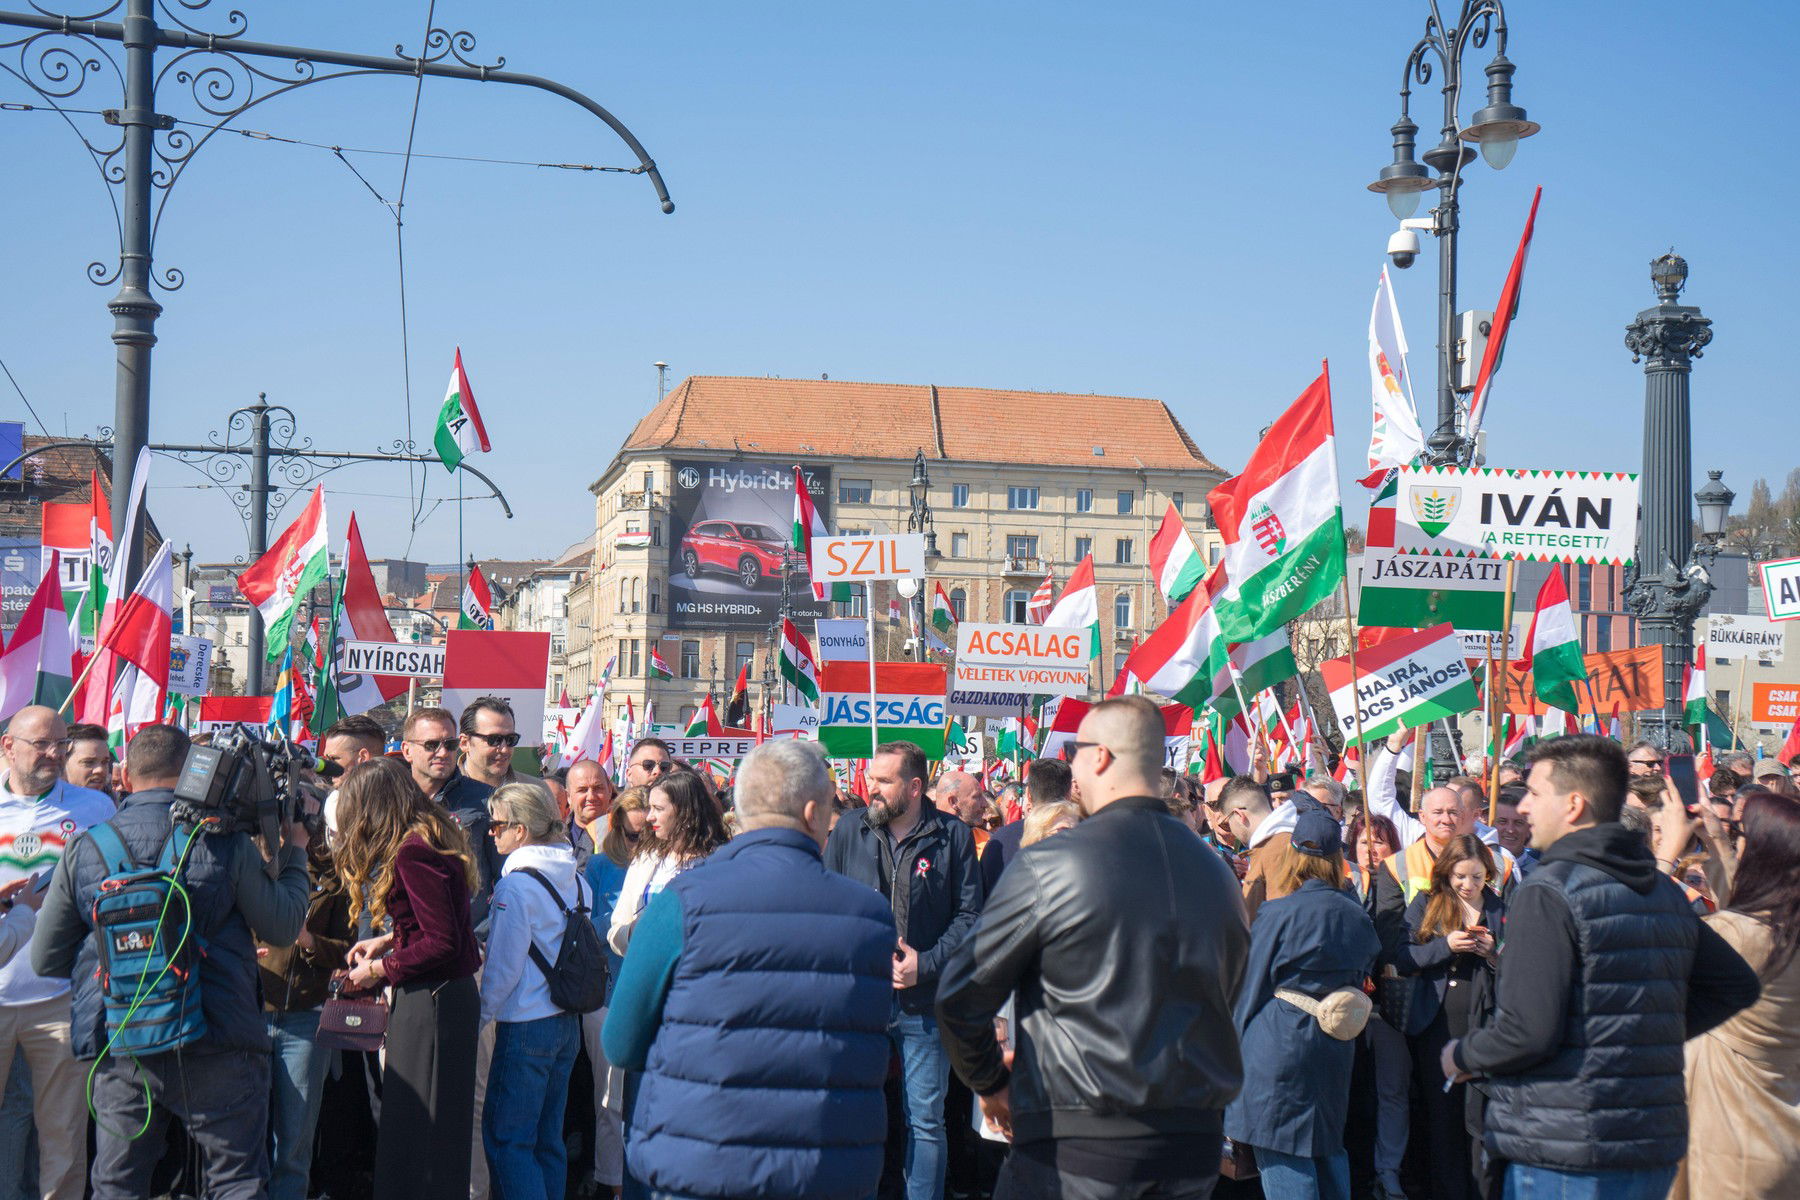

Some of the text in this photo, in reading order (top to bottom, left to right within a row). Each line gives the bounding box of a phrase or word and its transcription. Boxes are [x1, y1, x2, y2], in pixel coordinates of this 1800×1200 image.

[679, 468, 793, 493] MG Hybrid+
[1481, 488, 1612, 529] IVÁN
[827, 540, 911, 576] SZIL
[1372, 555, 1502, 580] JÁSZAPÁTI
[676, 603, 761, 615] MG HS HYBRID+
[820, 633, 865, 647] BONYHÁD
[967, 630, 1080, 659] ACSALAG
[1710, 629, 1783, 645] BÜKKÁBRÁNY
[193, 643, 208, 688] Derecske
[348, 646, 444, 674] NYÍRCSAH
[957, 668, 1087, 684] VELETEK VAGYUNK
[1358, 659, 1428, 701] HAJRÁ,
[1398, 660, 1466, 703] JÁNOS!
[820, 695, 943, 726] JÁSZSÁG
